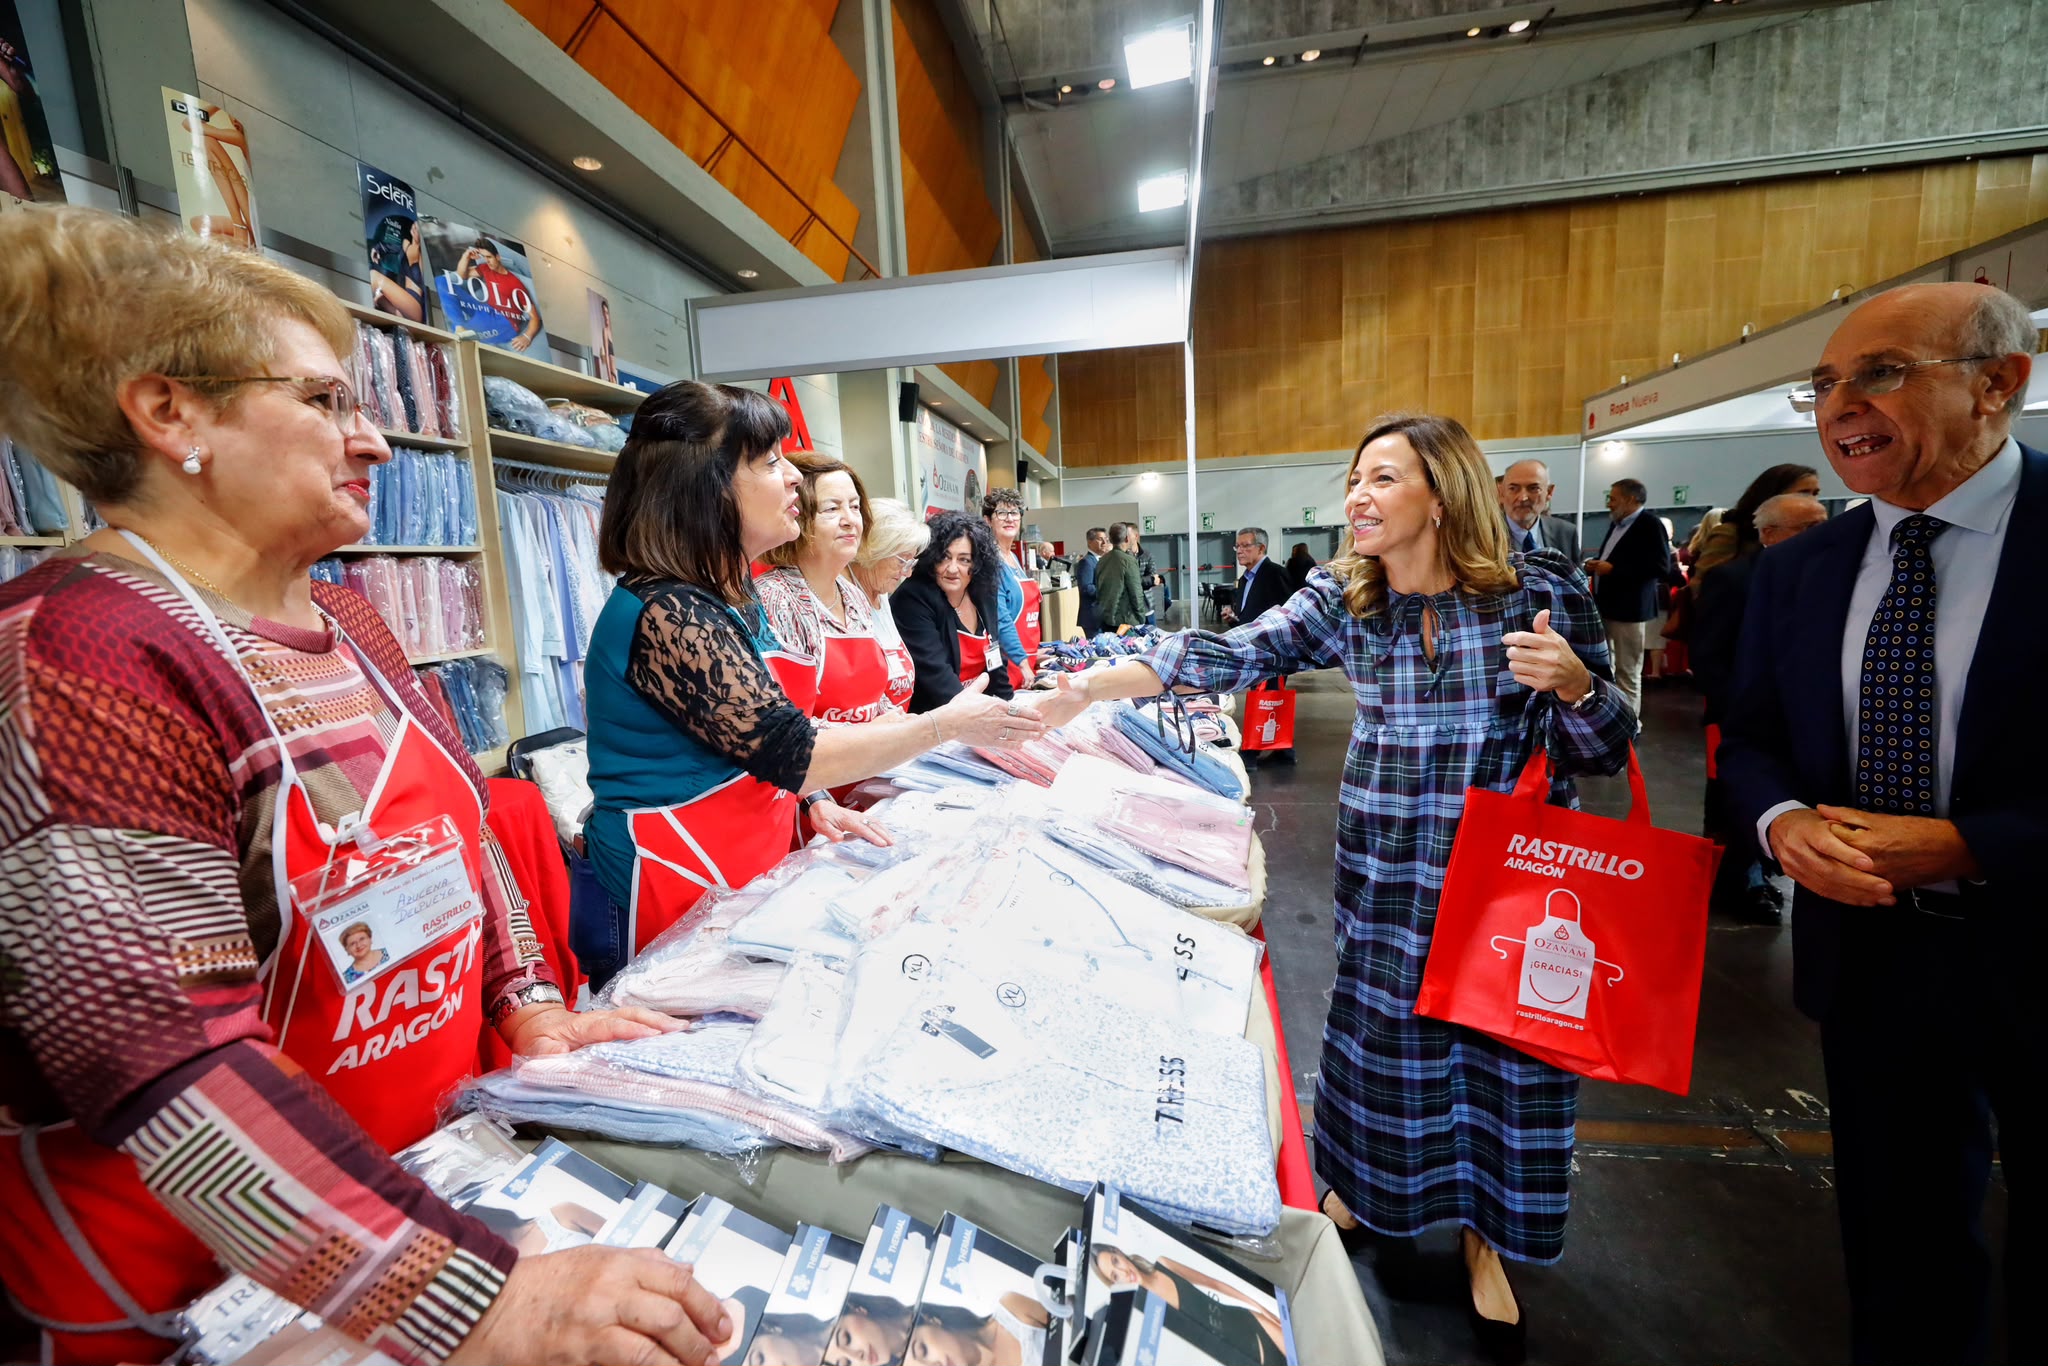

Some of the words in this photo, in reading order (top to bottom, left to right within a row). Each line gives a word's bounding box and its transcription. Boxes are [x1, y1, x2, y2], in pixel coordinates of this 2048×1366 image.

[175, 102, 205, 119] DM
[366, 174, 415, 213] Selene
[442, 268, 532, 313] POLO
[459, 300, 491, 313] RALPH
[494, 308, 528, 321] LAUREN
[1609, 401, 1630, 417] Ropa
[1631, 391, 1659, 409] Nueva
[821, 701, 880, 722] RAST
[1503, 856, 1567, 879] ARAGÓN
[330, 902, 370, 926] OZANAM
[422, 900, 472, 933] RASTRILLO
[1534, 937, 1587, 958] OZANAM
[910, 961, 923, 974] XL
[1530, 960, 1584, 979] ¡GRACIAS!
[1003, 989, 1020, 1003] XL
[326, 984, 464, 1075] ARAGÓN
[1516, 1010, 1585, 1032] rastrilloaragon.es
[887, 1218, 906, 1254] THERMAL
[957, 1228, 973, 1263] THERMAL
[806, 1235, 827, 1270] THERMAL
